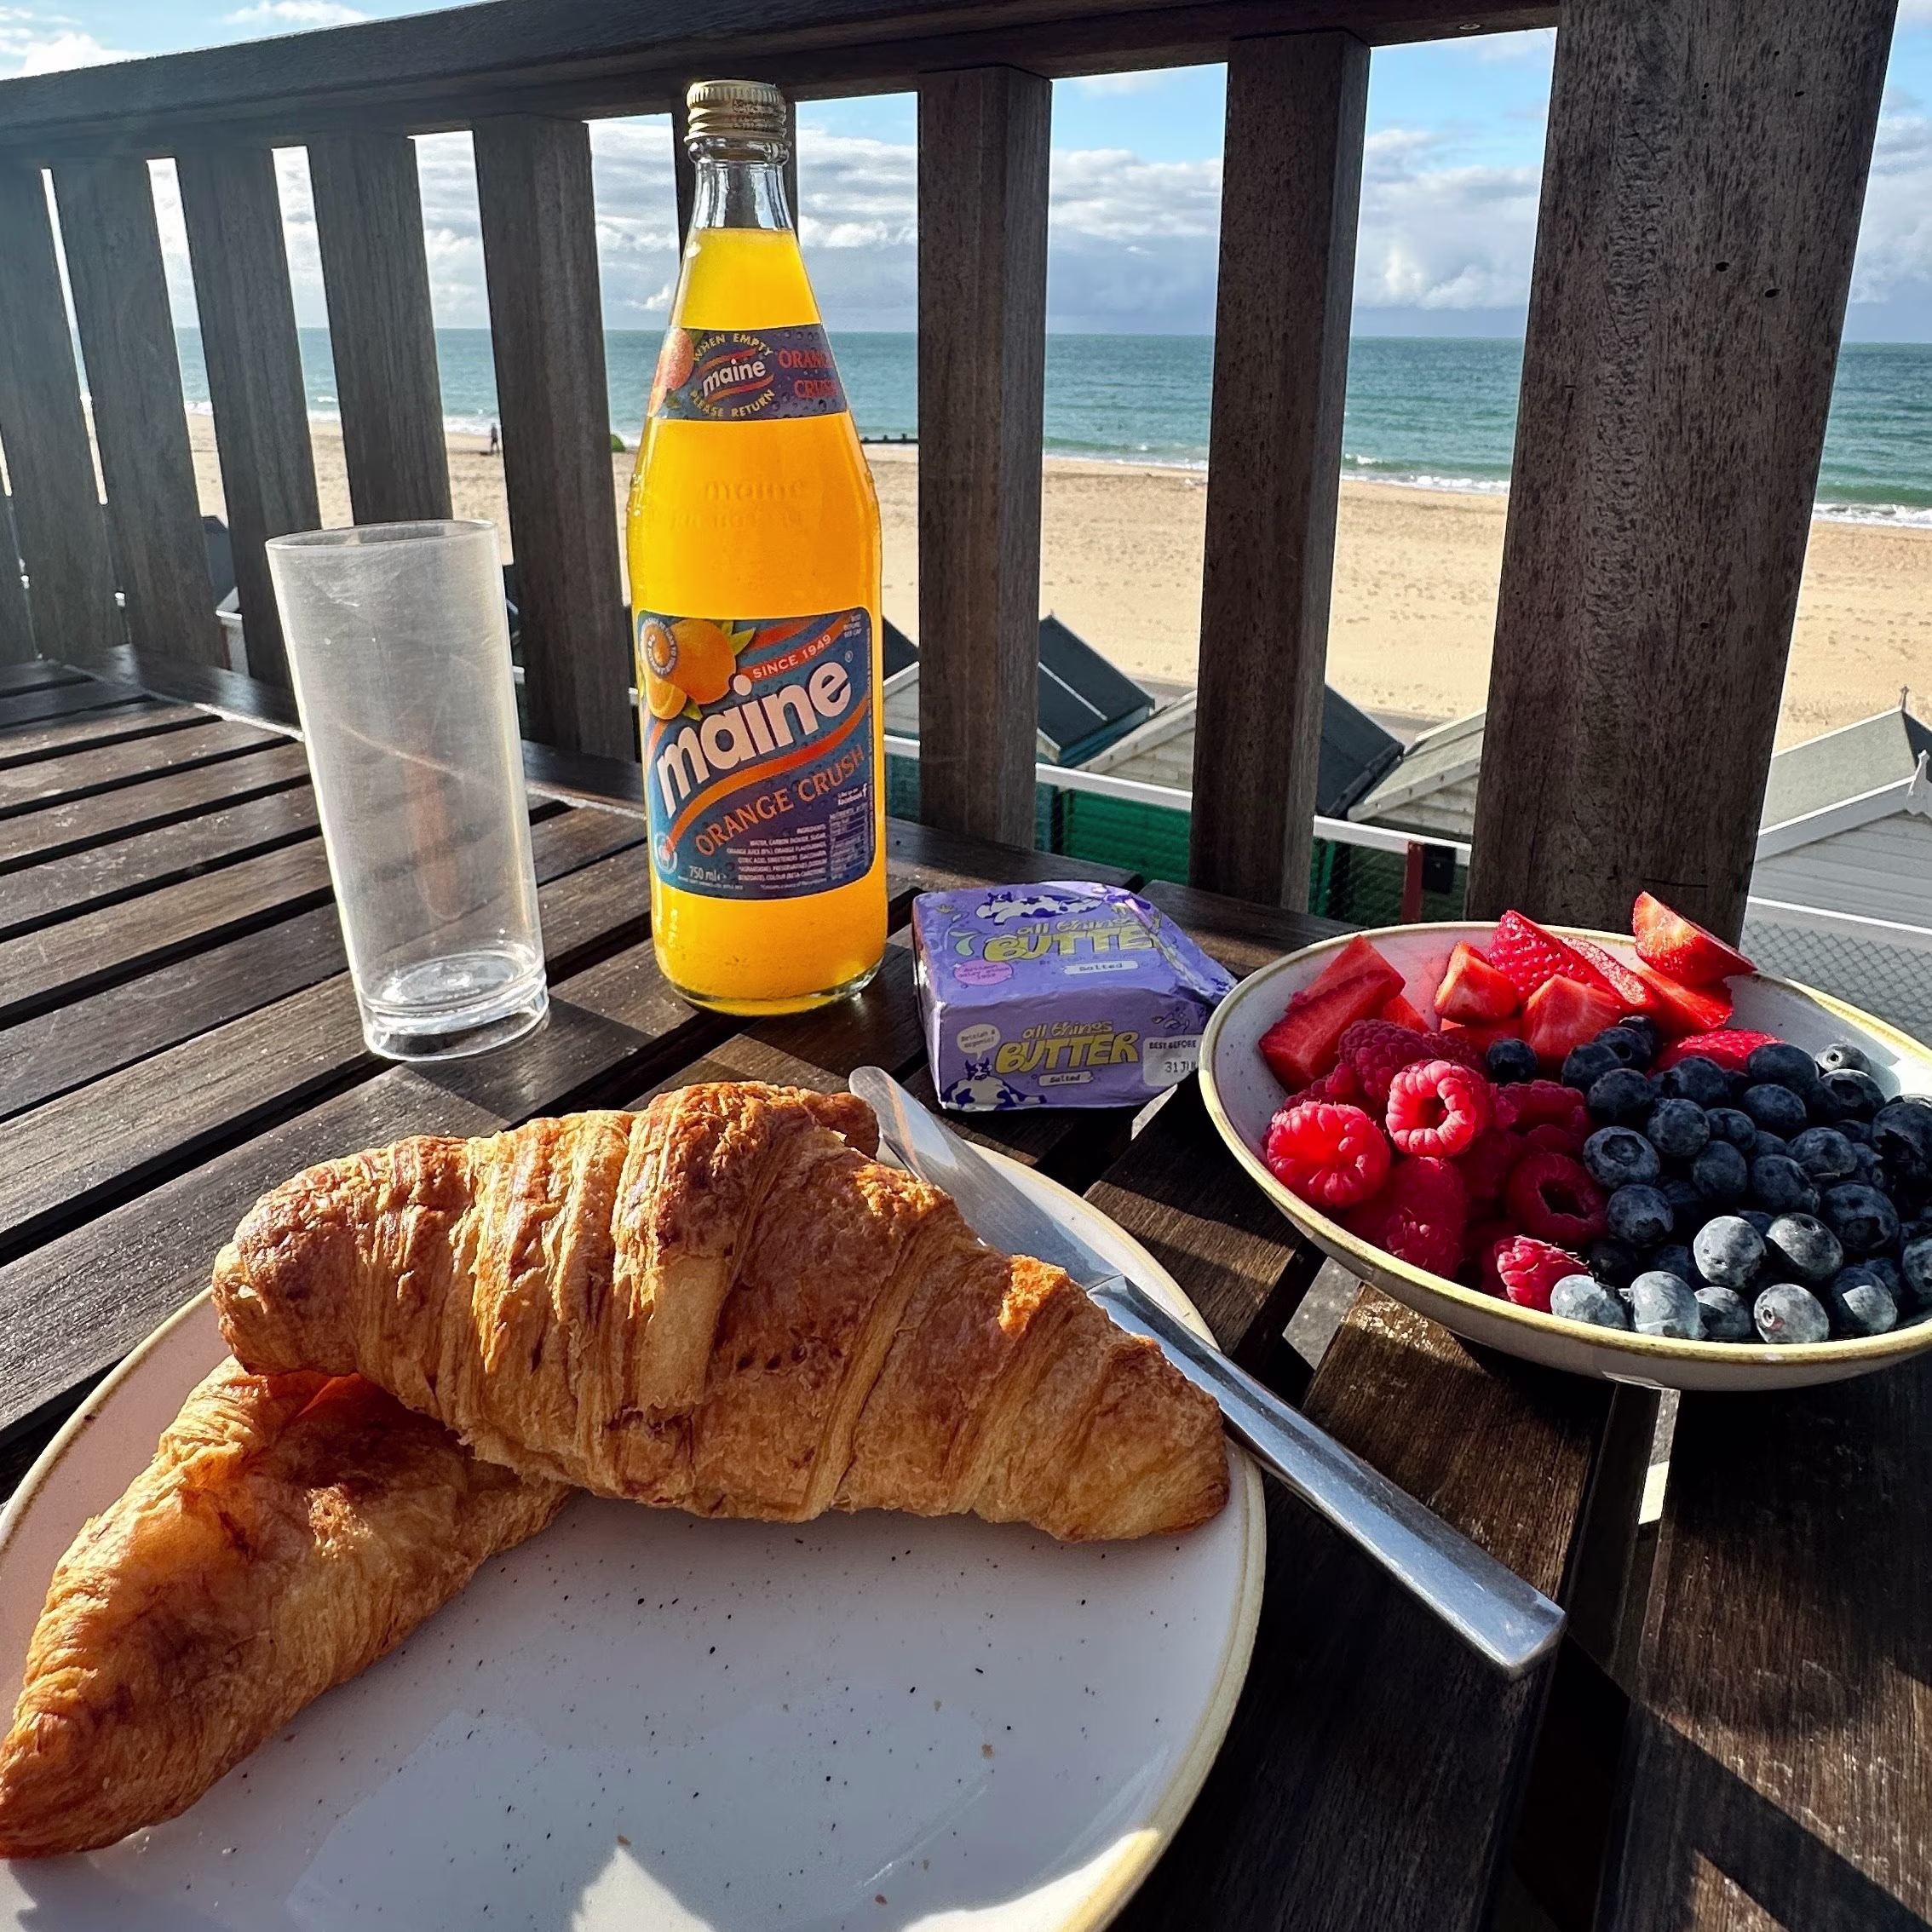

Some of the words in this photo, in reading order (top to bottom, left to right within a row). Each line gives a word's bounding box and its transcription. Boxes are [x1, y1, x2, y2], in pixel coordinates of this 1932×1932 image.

[693, 333, 726, 362] WHEN
[733, 333, 773, 356] EMPTY
[703, 358, 766, 398] maine
[690, 389, 724, 418] PLEASE
[731, 389, 775, 417] RETURN
[753, 655, 799, 679] SINCE
[802, 635, 831, 659] 1949
[657, 662, 851, 819] maine
[695, 787, 794, 857] ORANGE
[798, 744, 865, 802] CRUSH
[983, 925, 1154, 962] BUTTE
[1016, 922, 1049, 935] all
[1022, 1024, 1048, 1039] all
[1051, 1021, 1113, 1036] things
[1149, 1041, 1167, 1049] BEST
[1168, 1039, 1197, 1049] BEFORE
[995, 1030, 1140, 1074] BUTTER
[1049, 1073, 1081, 1084] Salted
